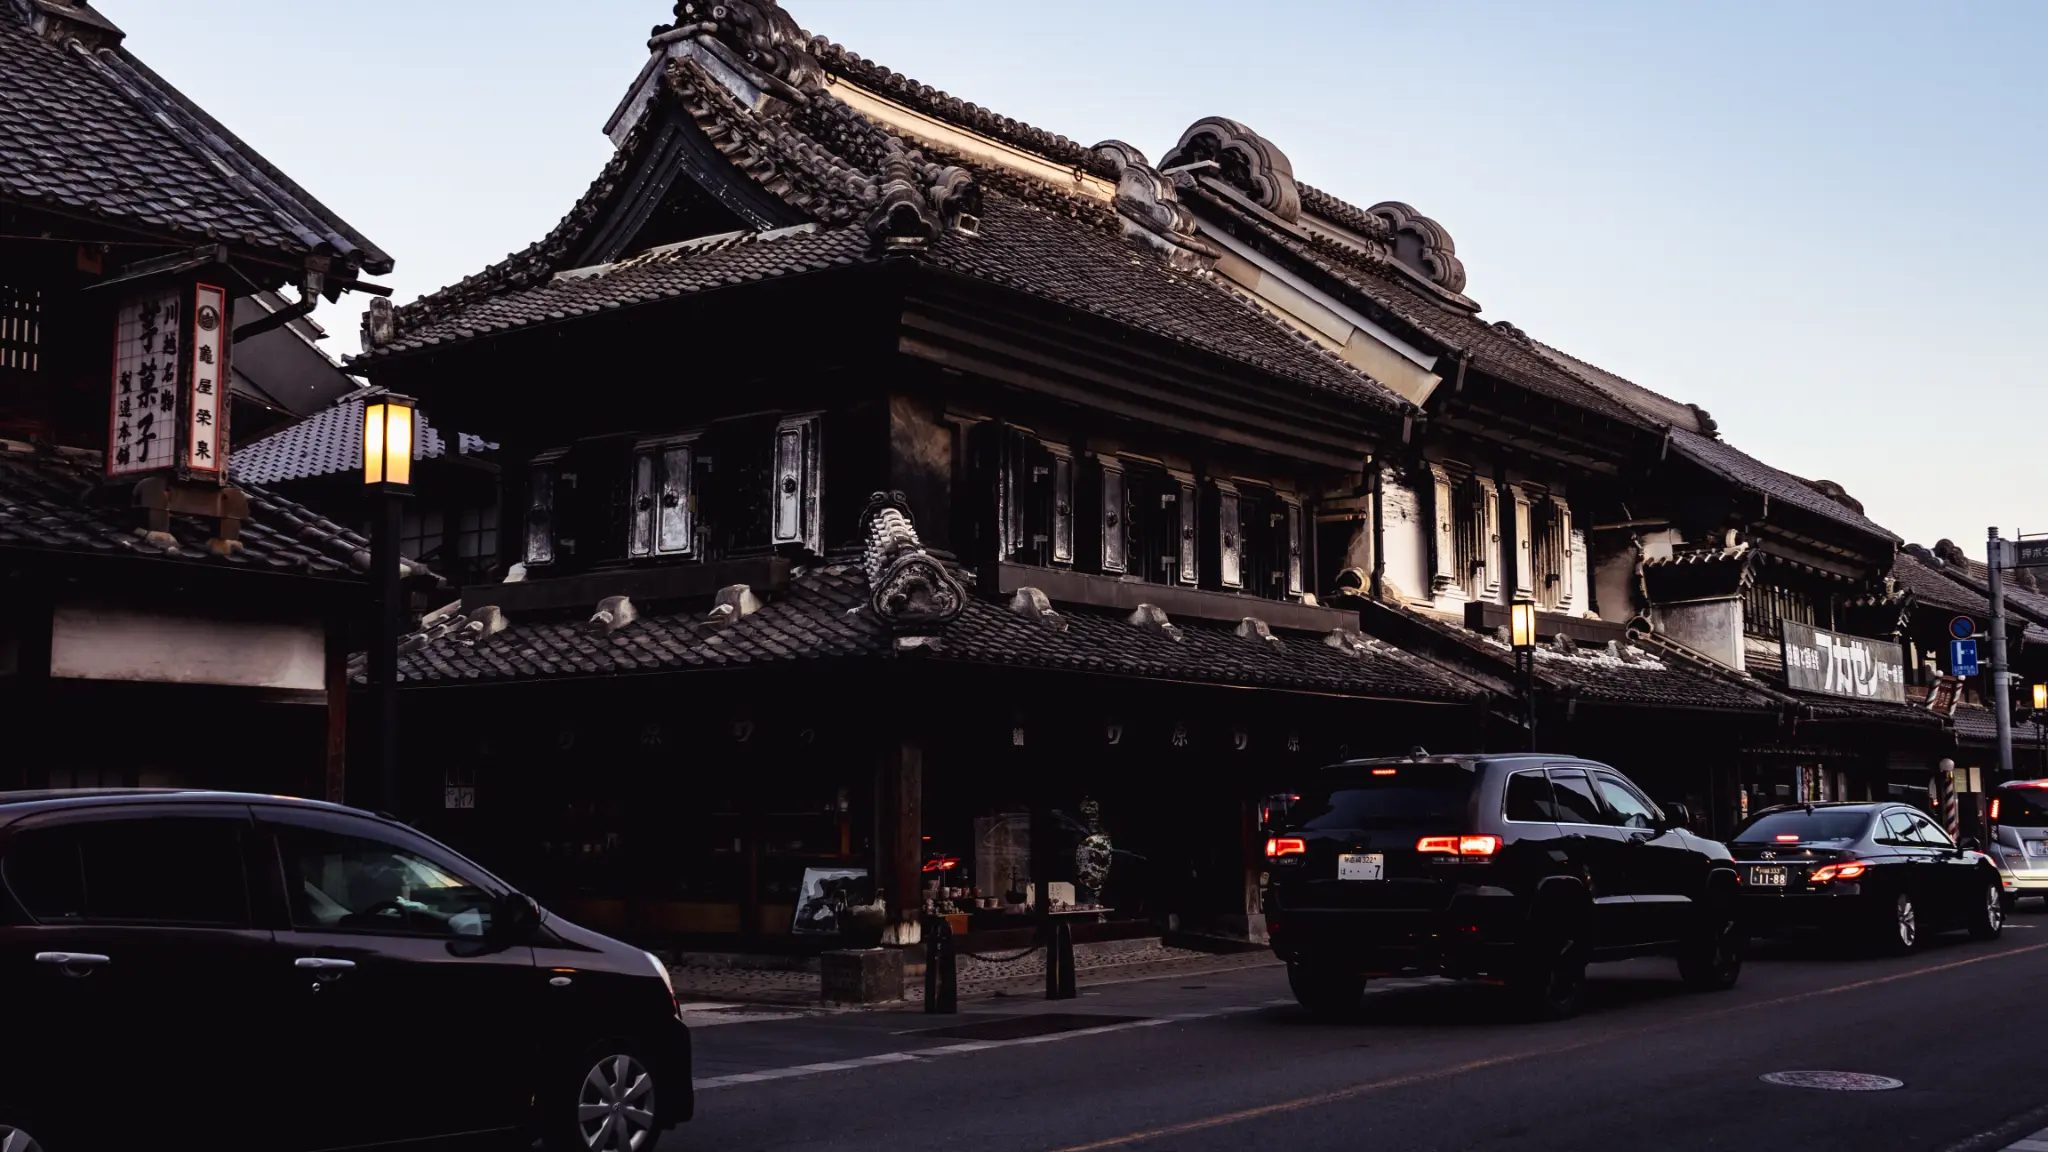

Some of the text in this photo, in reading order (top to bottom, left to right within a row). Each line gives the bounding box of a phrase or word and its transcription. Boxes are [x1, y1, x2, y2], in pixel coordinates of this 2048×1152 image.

[136, 300, 161, 463] 芋菓子
[161, 299, 179, 412] 川越名物
